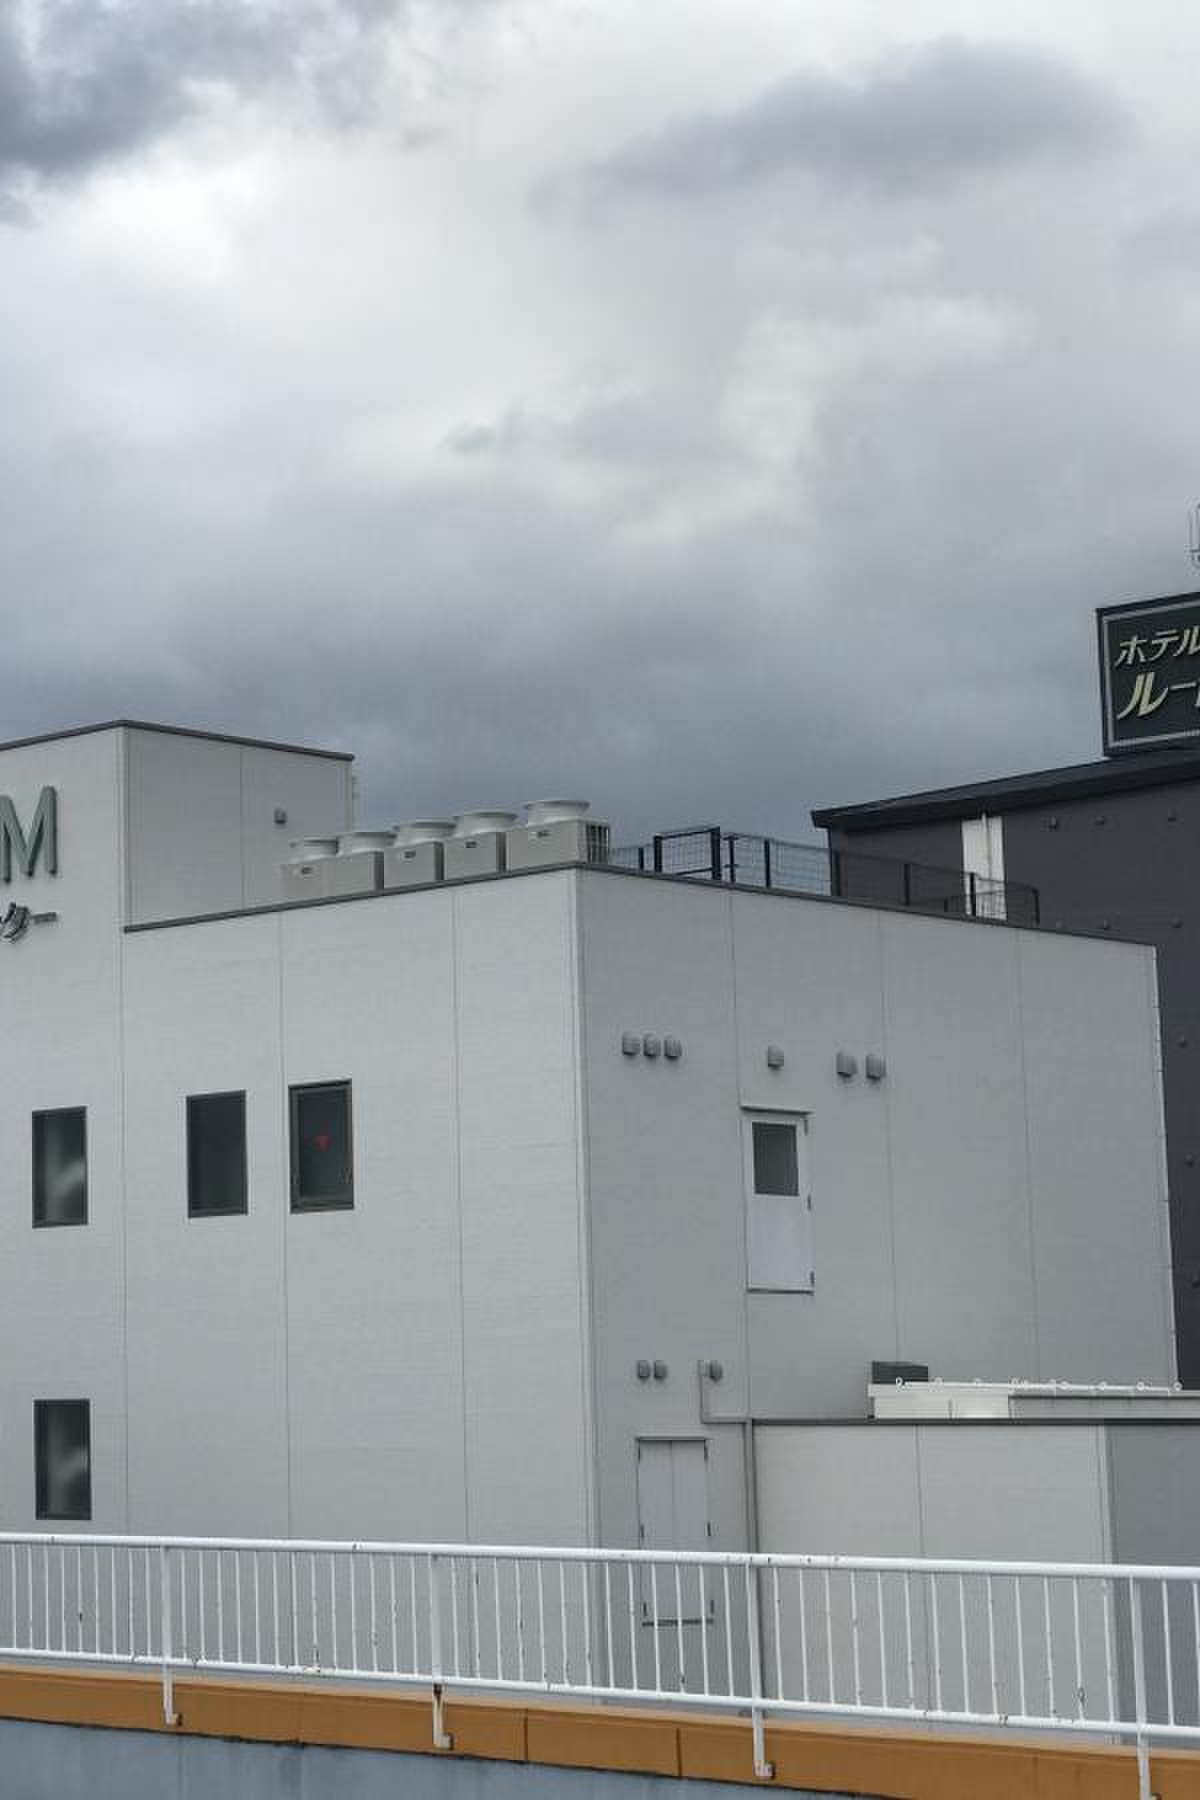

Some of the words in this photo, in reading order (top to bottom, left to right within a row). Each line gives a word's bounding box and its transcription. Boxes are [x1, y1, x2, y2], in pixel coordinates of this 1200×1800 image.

[1114, 625, 1200, 669] ホテル
[1116, 671, 1200, 720] ルー
